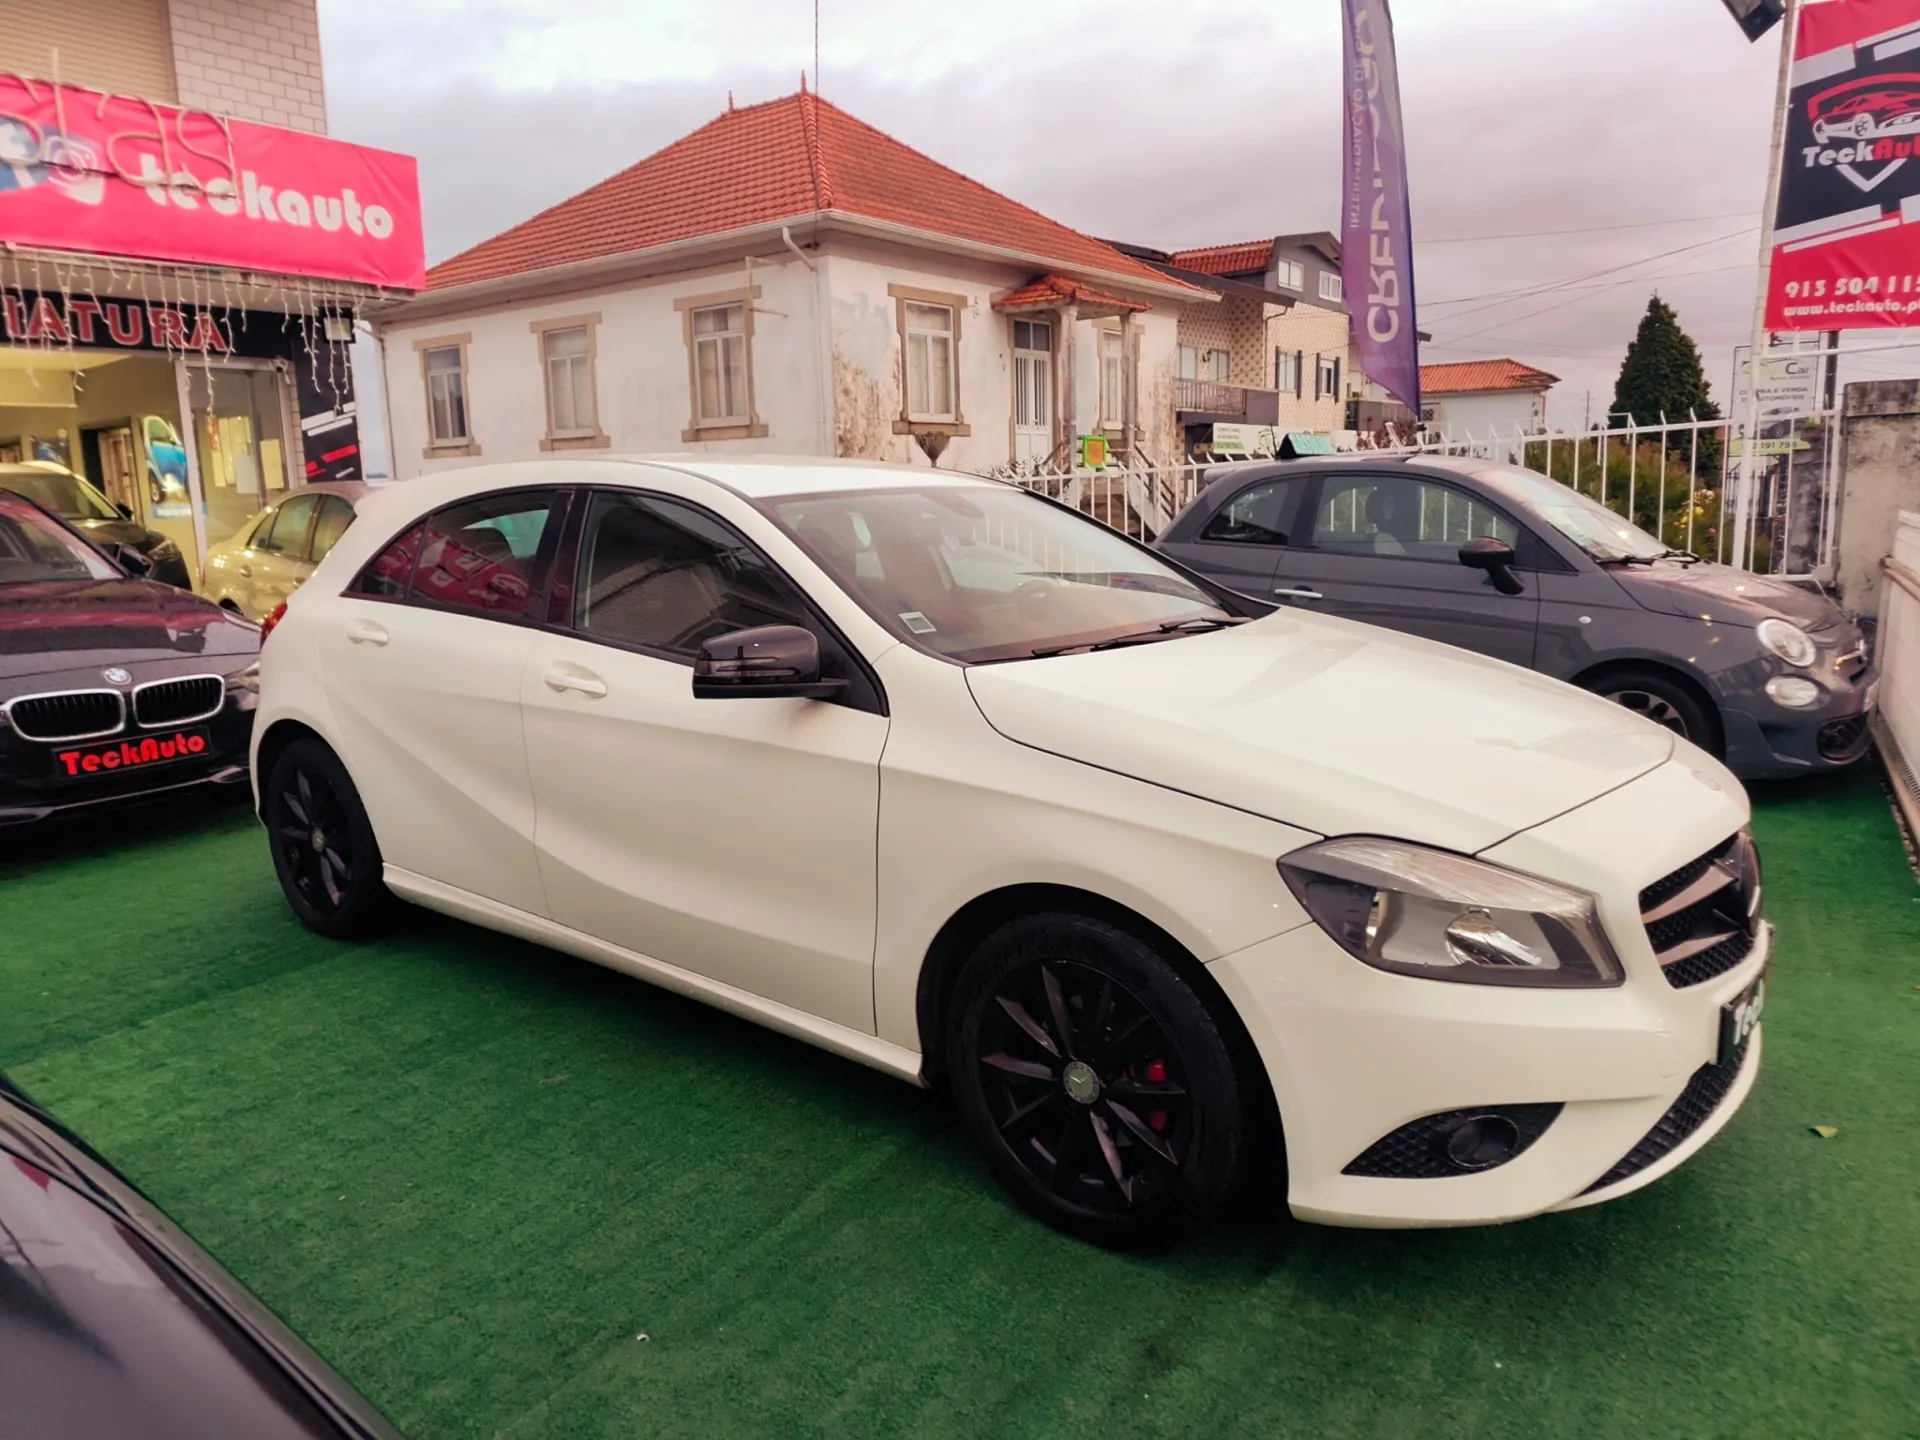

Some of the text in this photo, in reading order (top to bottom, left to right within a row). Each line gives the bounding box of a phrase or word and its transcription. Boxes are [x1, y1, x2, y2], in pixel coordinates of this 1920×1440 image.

[1784, 279, 1827, 298] 913
[1834, 276, 1880, 296] 504
[1783, 299, 1920, 317] www.teckauto.p
[59, 732, 205, 776] TeckAuto
